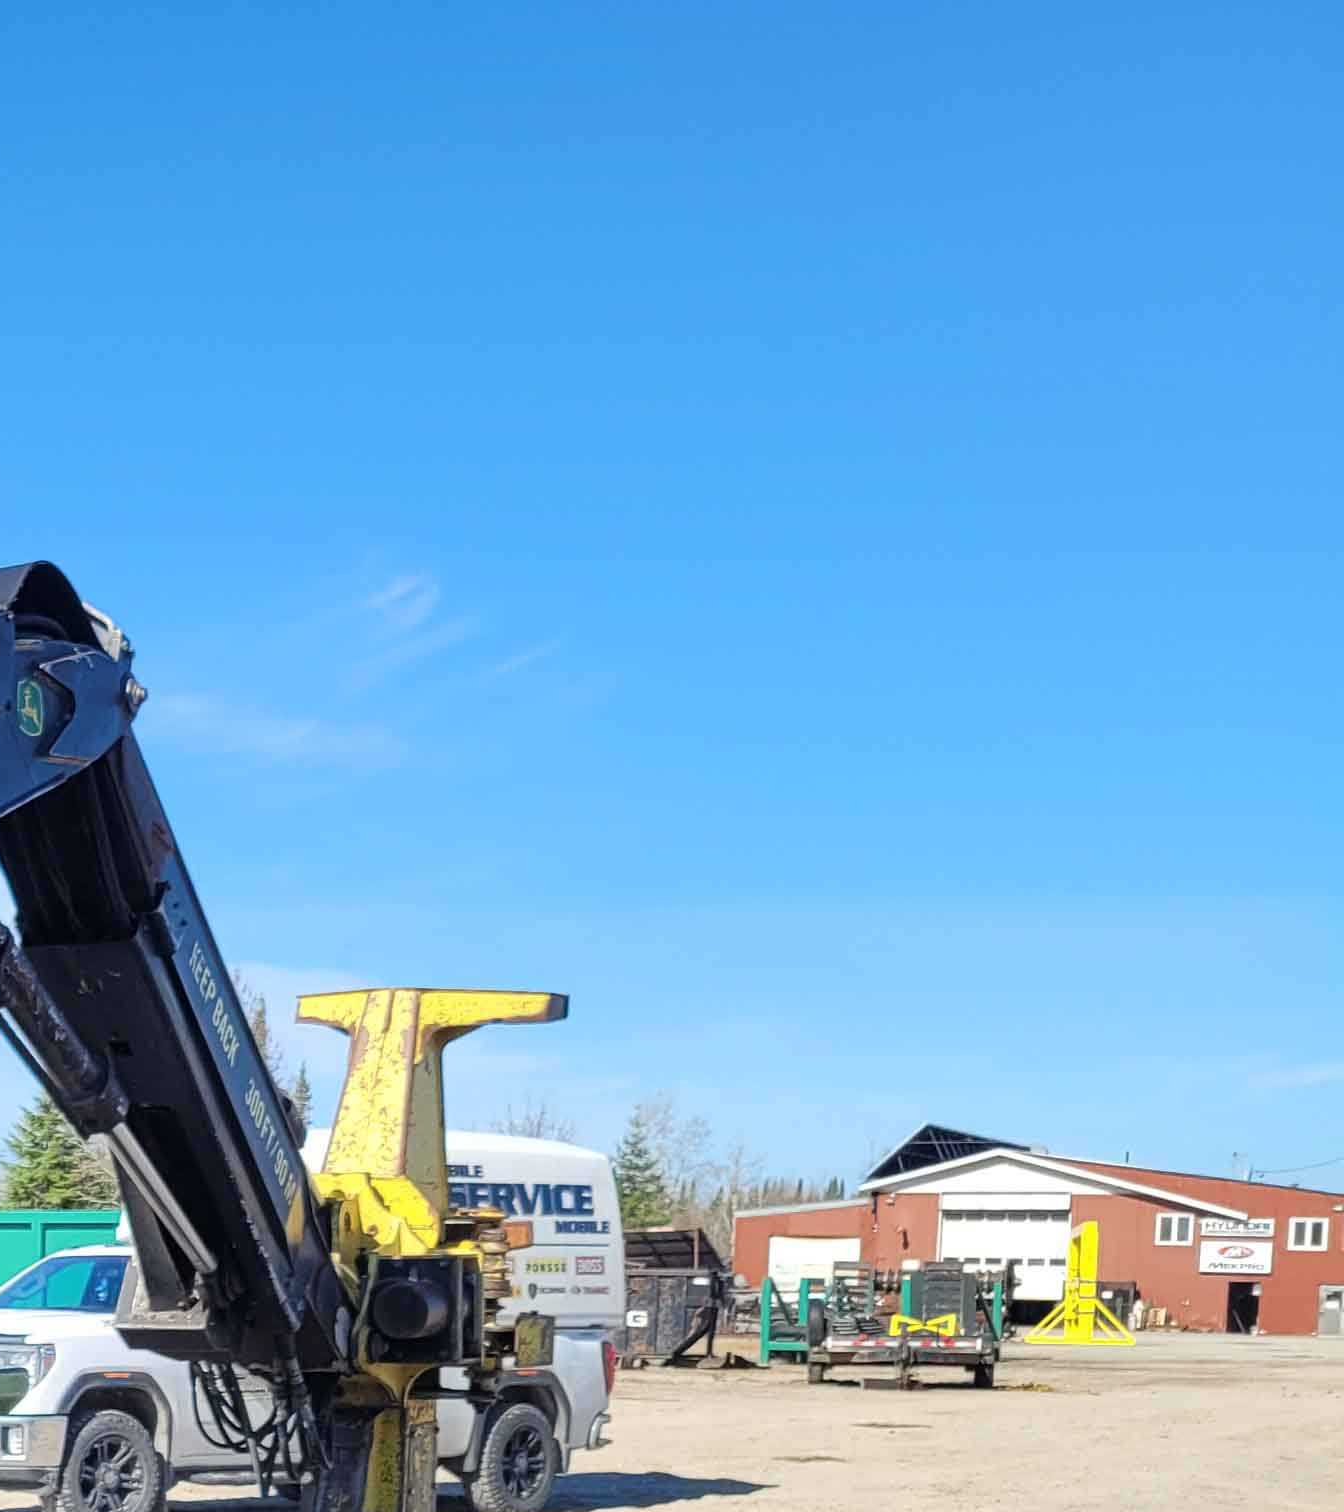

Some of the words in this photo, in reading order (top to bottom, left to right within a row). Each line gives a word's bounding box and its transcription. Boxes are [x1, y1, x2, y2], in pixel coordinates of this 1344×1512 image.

[188, 943, 217, 1002] KEEP
[211, 1000, 241, 1066] BACK
[448, 1182, 595, 1216] SERVICE
[555, 1220, 609, 1234] MOBILE
